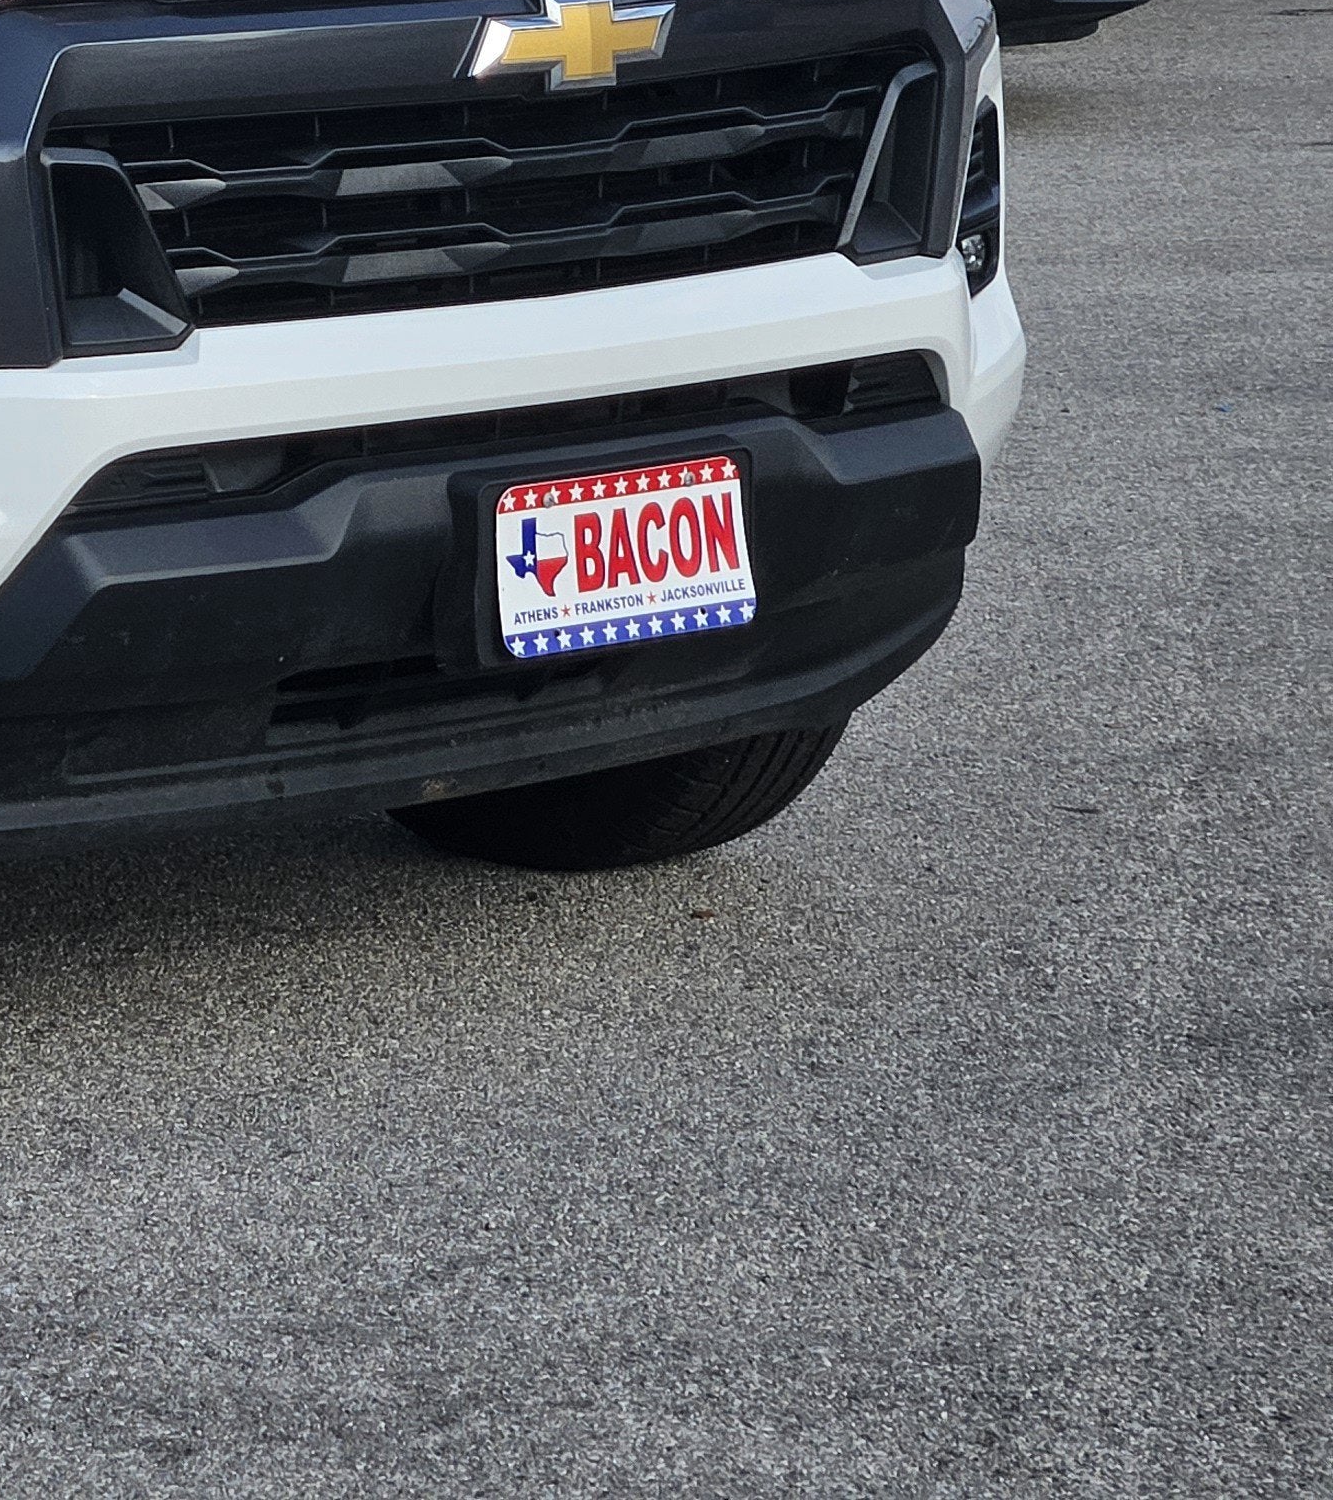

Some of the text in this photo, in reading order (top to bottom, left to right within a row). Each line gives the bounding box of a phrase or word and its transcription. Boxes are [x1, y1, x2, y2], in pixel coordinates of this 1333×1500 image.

[574, 491, 740, 593] BACON
[514, 578, 746, 626] ATHENS FRANKSTON JACKSONVILLE
